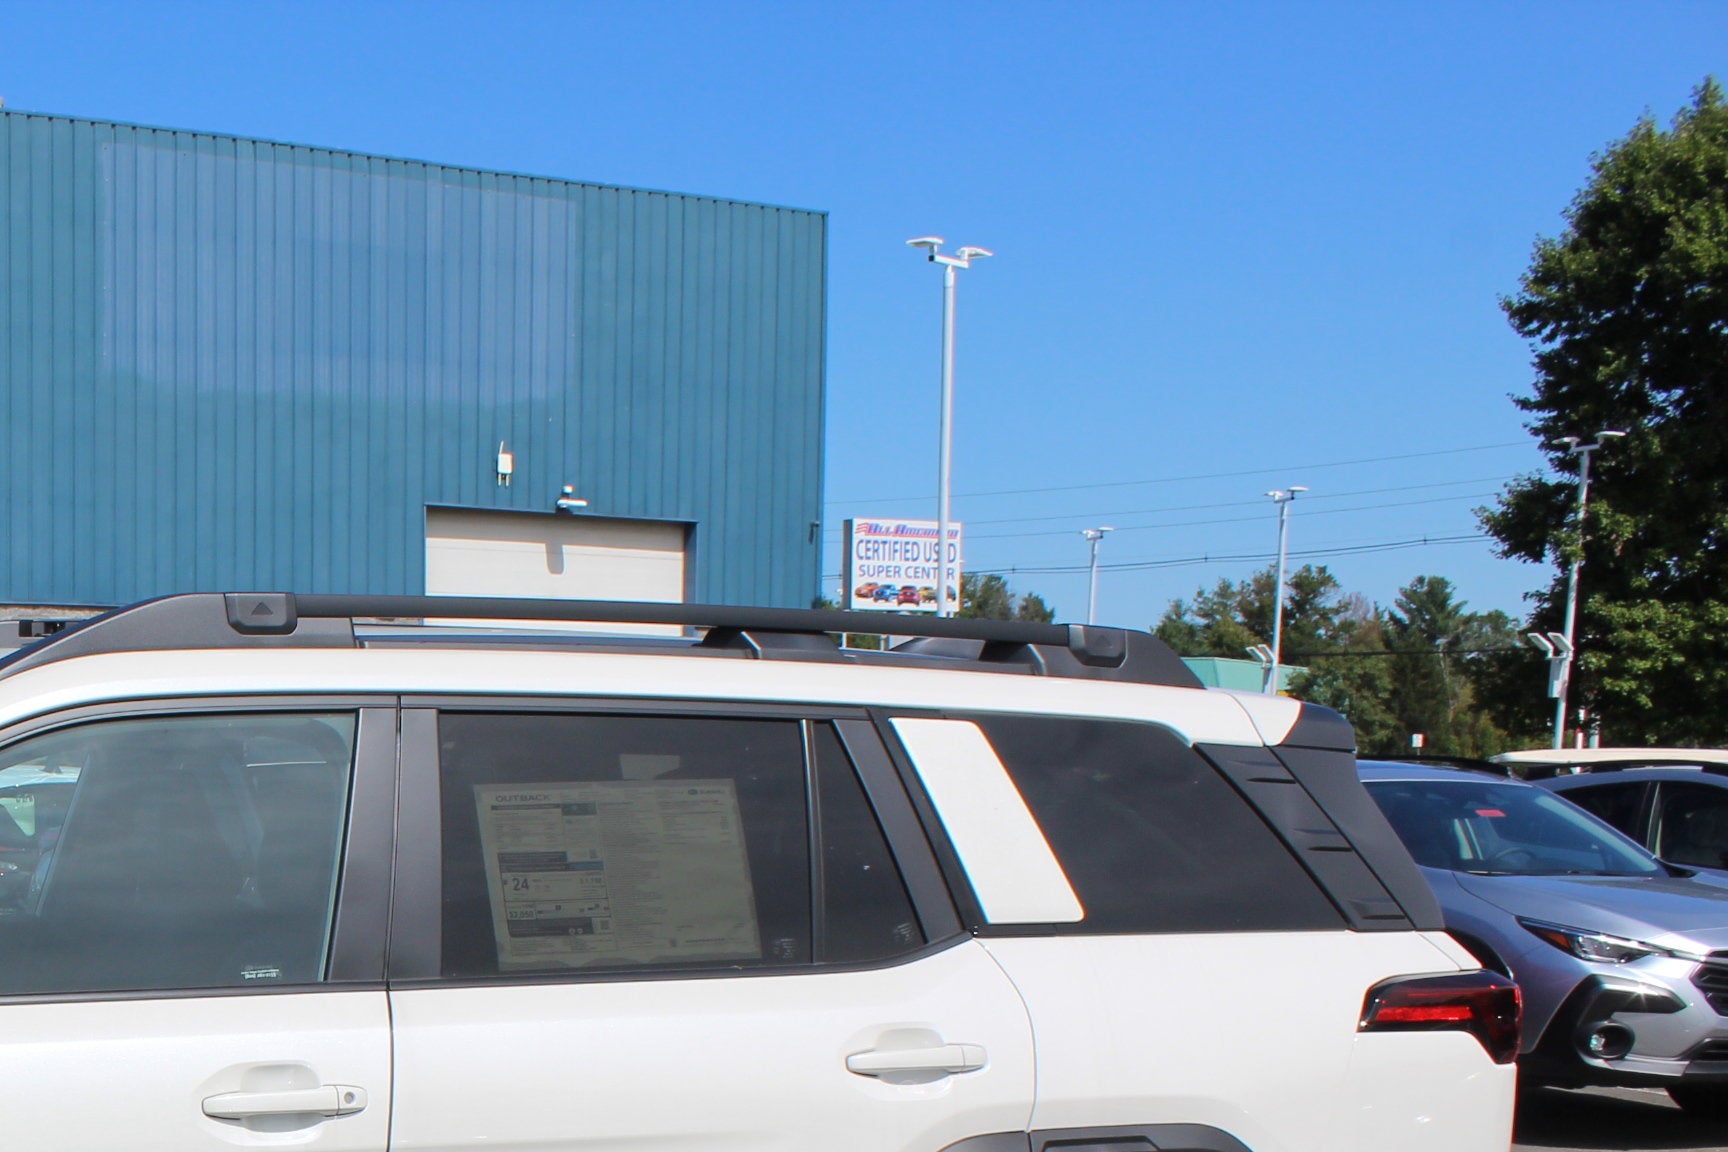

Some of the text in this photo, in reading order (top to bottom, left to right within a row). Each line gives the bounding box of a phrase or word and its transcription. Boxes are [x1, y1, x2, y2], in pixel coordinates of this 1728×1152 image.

[856, 539, 956, 563] CERTIFIED USD
[859, 564, 954, 580] SUPER CENTR
[495, 793, 551, 803] OUTBACK
[512, 877, 529, 892] 24
